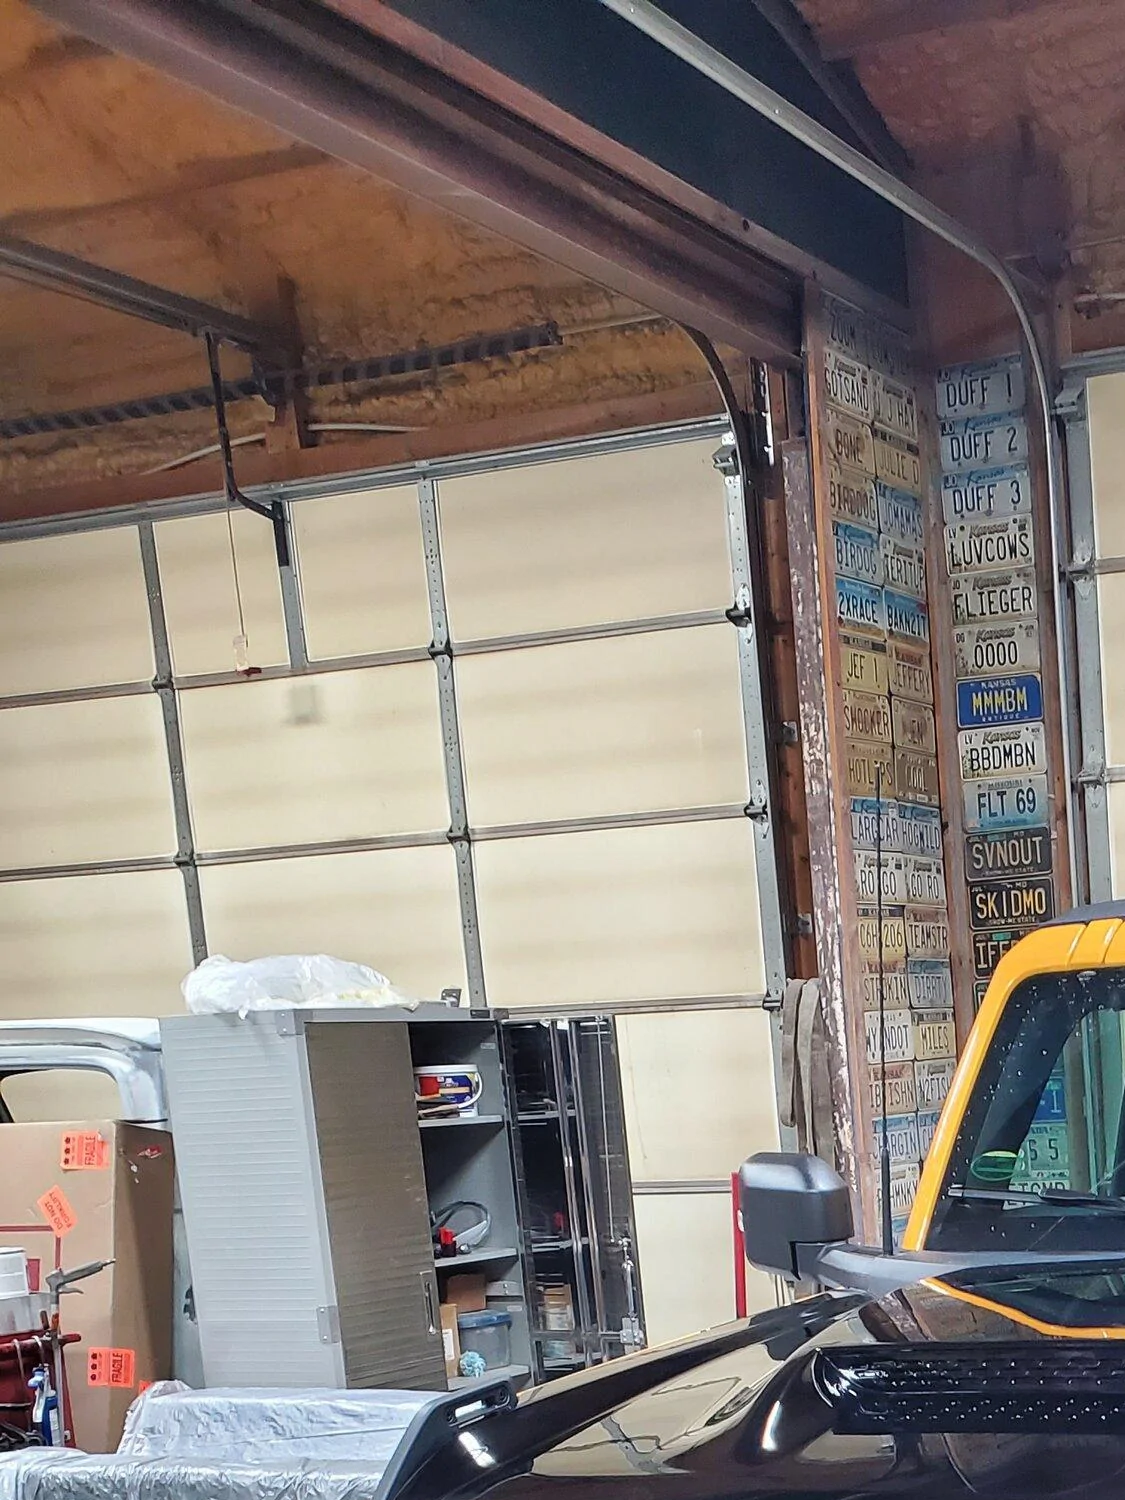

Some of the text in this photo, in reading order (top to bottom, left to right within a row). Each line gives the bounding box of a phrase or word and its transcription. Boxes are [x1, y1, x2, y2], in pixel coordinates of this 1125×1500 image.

[824, 367, 869, 411] GOTSAND
[946, 373, 1012, 408] DUFF 1
[835, 428, 863, 463] BONE
[950, 426, 1017, 461] DUFF 2
[879, 448, 908, 481] JULIE
[829, 480, 876, 521] BIRDDOG
[952, 480, 1021, 514] DUFF 3
[883, 499, 924, 538] JOMAMAS
[968, 522, 1010, 539] Kansas
[836, 538, 877, 575] BIRDOG
[950, 533, 1030, 567] LUVCOWS
[972, 575, 1012, 591] Kansas
[838, 591, 878, 624] 2XRACE
[953, 586, 1033, 620] FLIEGER
[887, 604, 927, 638] BAKN2IT
[976, 627, 1015, 643] Kansas
[847, 652, 865, 679] JEF
[893, 662, 930, 695] JEFFERY
[981, 678, 1017, 689] KANSAS
[972, 686, 1028, 717] MMMBM
[844, 705, 890, 737] SHOCKER
[964, 734, 973, 745] LV
[982, 730, 1021, 745] Kansas
[970, 741, 1036, 772] BBDMBN
[848, 759, 892, 786] HOTLPS
[977, 787, 1036, 819] FLT 69
[902, 821, 940, 850] HOGWILD
[972, 836, 1043, 869] SVNOUT
[860, 869, 897, 896] RO GO
[911, 873, 939, 899] GO RO
[976, 887, 1046, 919] SKIDMO
[883, 923, 903, 948] 206
[909, 924, 948, 949] TEAMSTR
[866, 1025, 909, 1053] WYNDOT
[920, 1026, 949, 1051] MILES
[869, 1080, 914, 1108] IBISHN
[112, 1352, 123, 1383] FRAGILE
